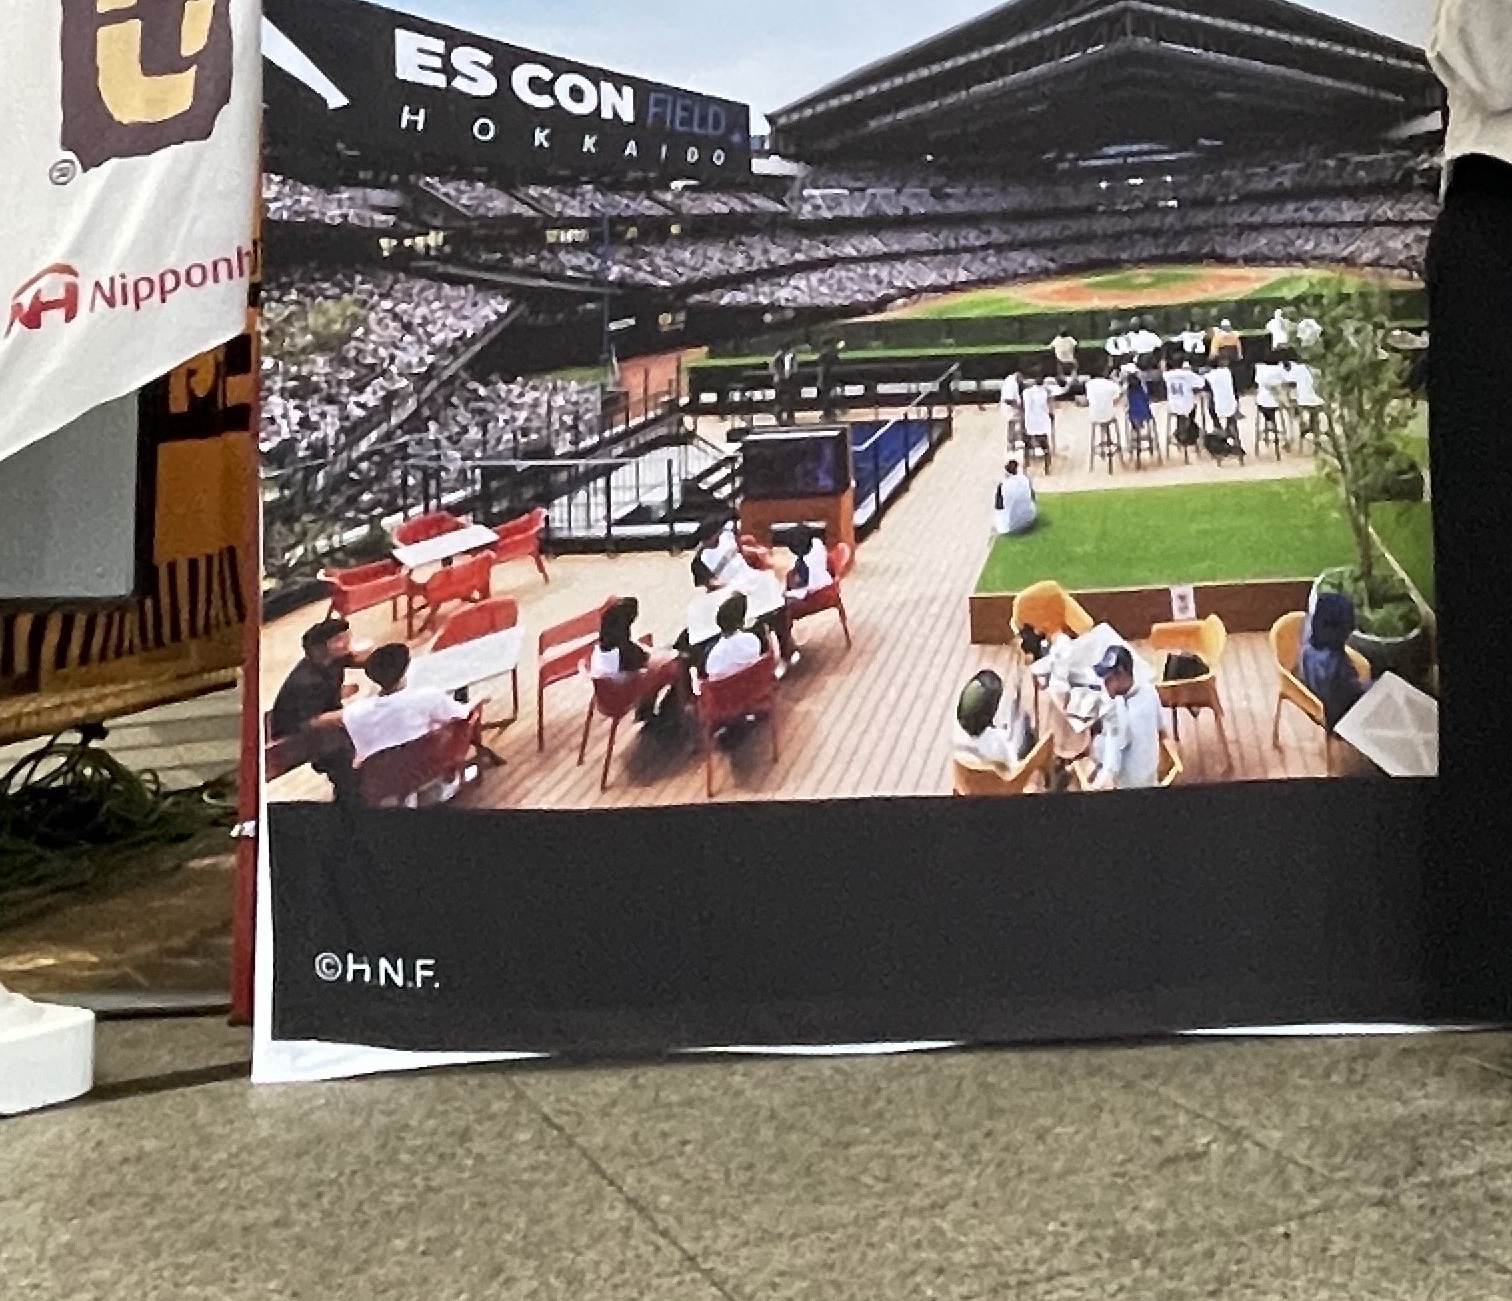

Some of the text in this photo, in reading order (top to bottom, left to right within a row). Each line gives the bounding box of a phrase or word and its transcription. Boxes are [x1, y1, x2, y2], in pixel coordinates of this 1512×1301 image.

[394, 27, 726, 136] ES CON FIELD
[400, 104, 726, 166] HOKKAIDO
